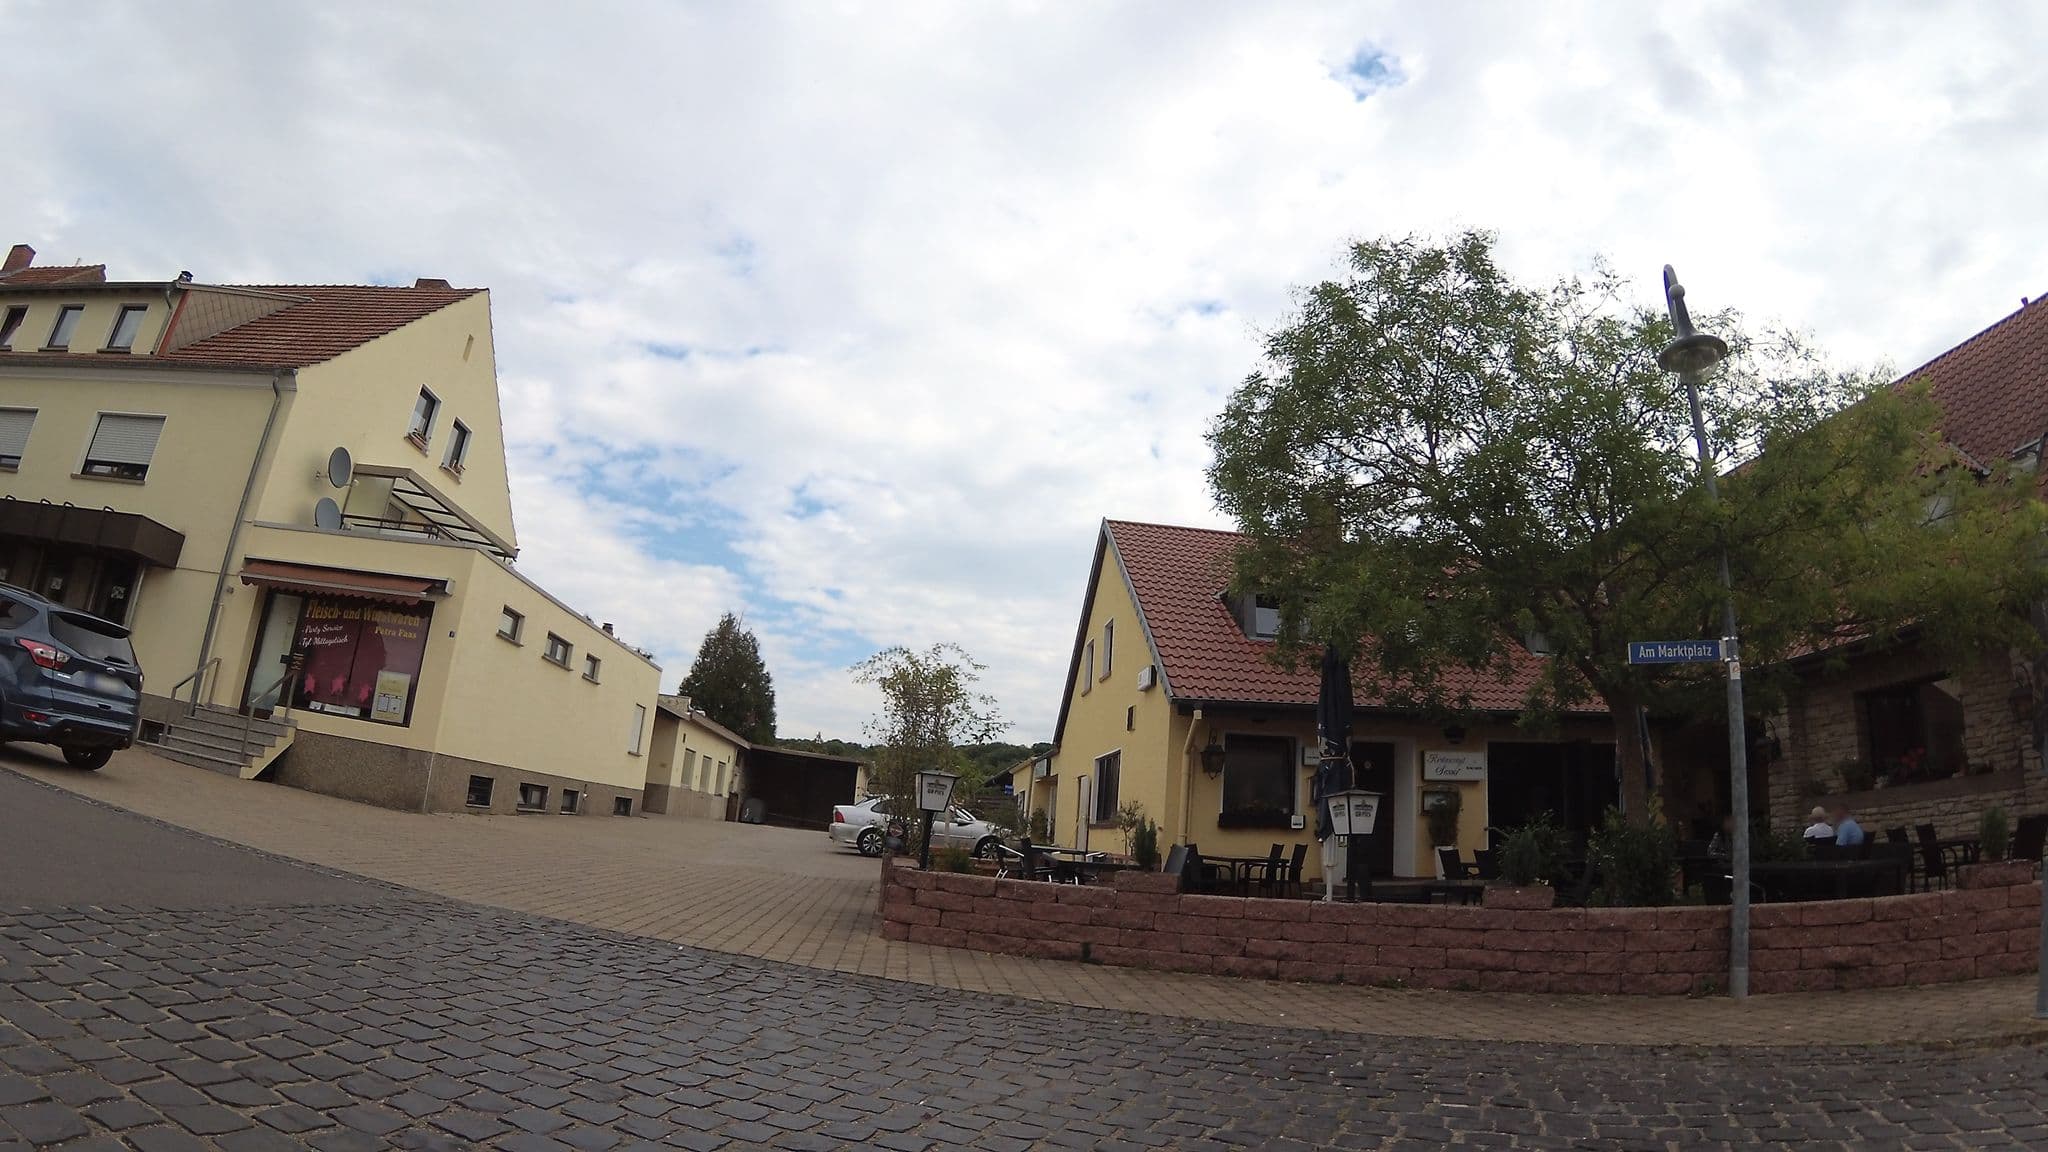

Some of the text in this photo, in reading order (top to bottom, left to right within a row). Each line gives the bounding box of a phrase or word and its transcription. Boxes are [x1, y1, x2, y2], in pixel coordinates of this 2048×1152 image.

[343, 608, 361, 620] und
[1639, 644, 1713, 660] Am Marktplatz
